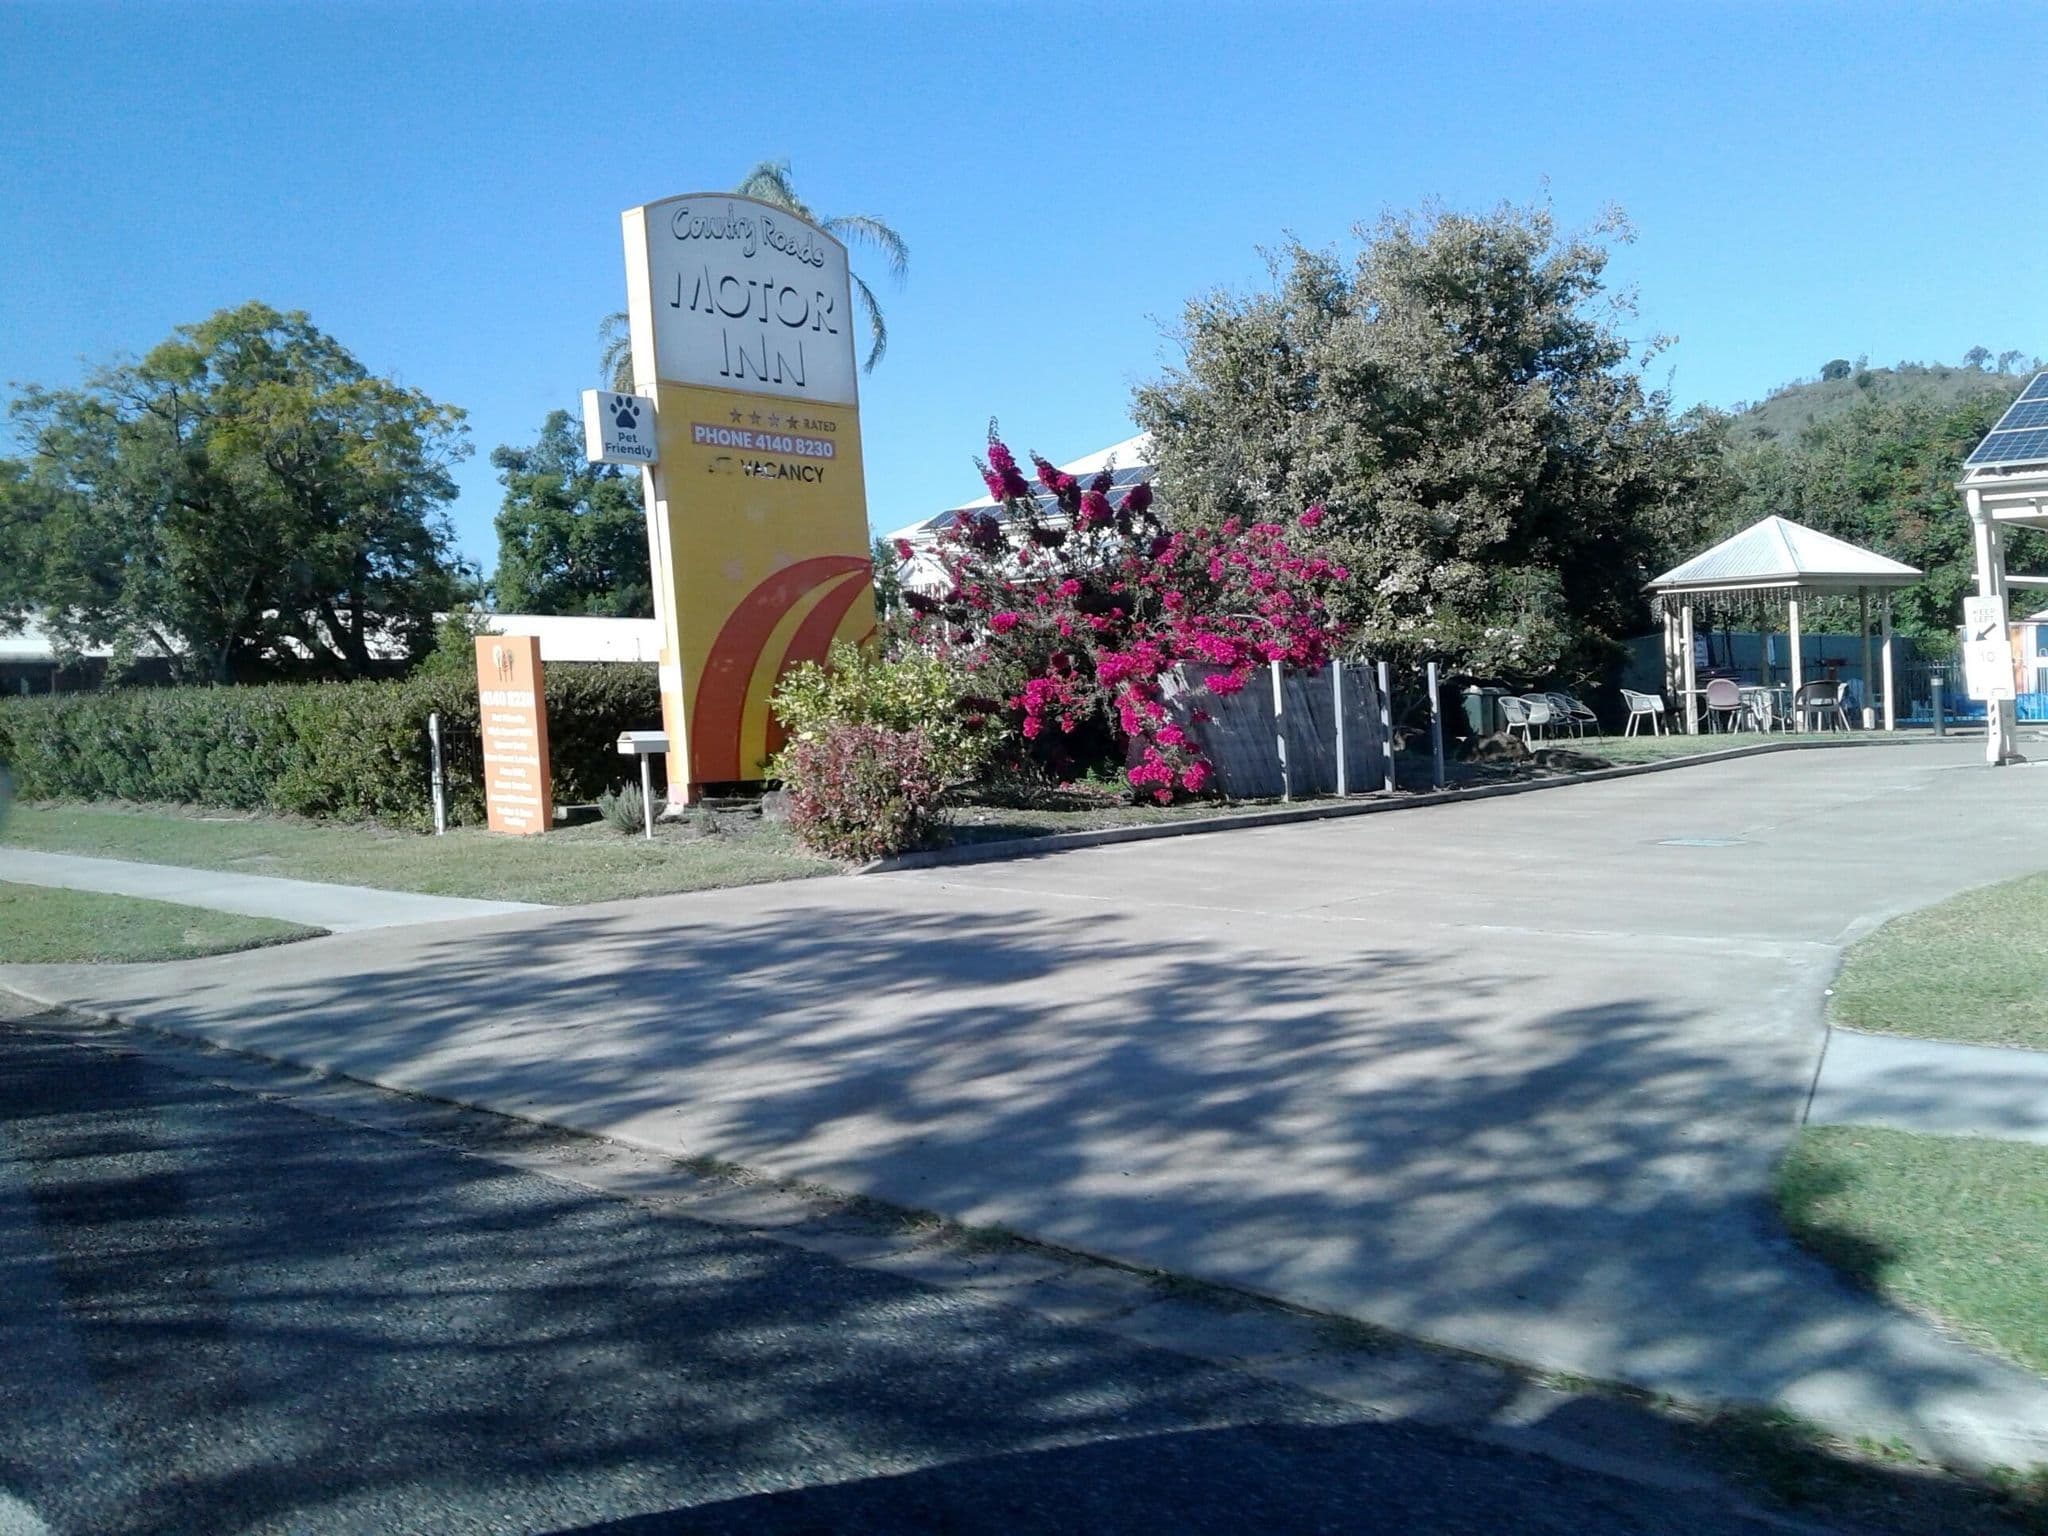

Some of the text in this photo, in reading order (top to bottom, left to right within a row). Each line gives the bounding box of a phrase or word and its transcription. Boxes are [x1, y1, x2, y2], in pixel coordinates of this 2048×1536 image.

[671, 203, 824, 268] Country Roads
[669, 264, 839, 335] MOTOR
[719, 328, 806, 387] INN
[618, 431, 638, 443] Pet
[803, 418, 836, 433] RATED
[605, 442, 653, 458] Friendly
[694, 425, 833, 457] PHONE 4140 8230
[741, 459, 825, 483] VACANCY
